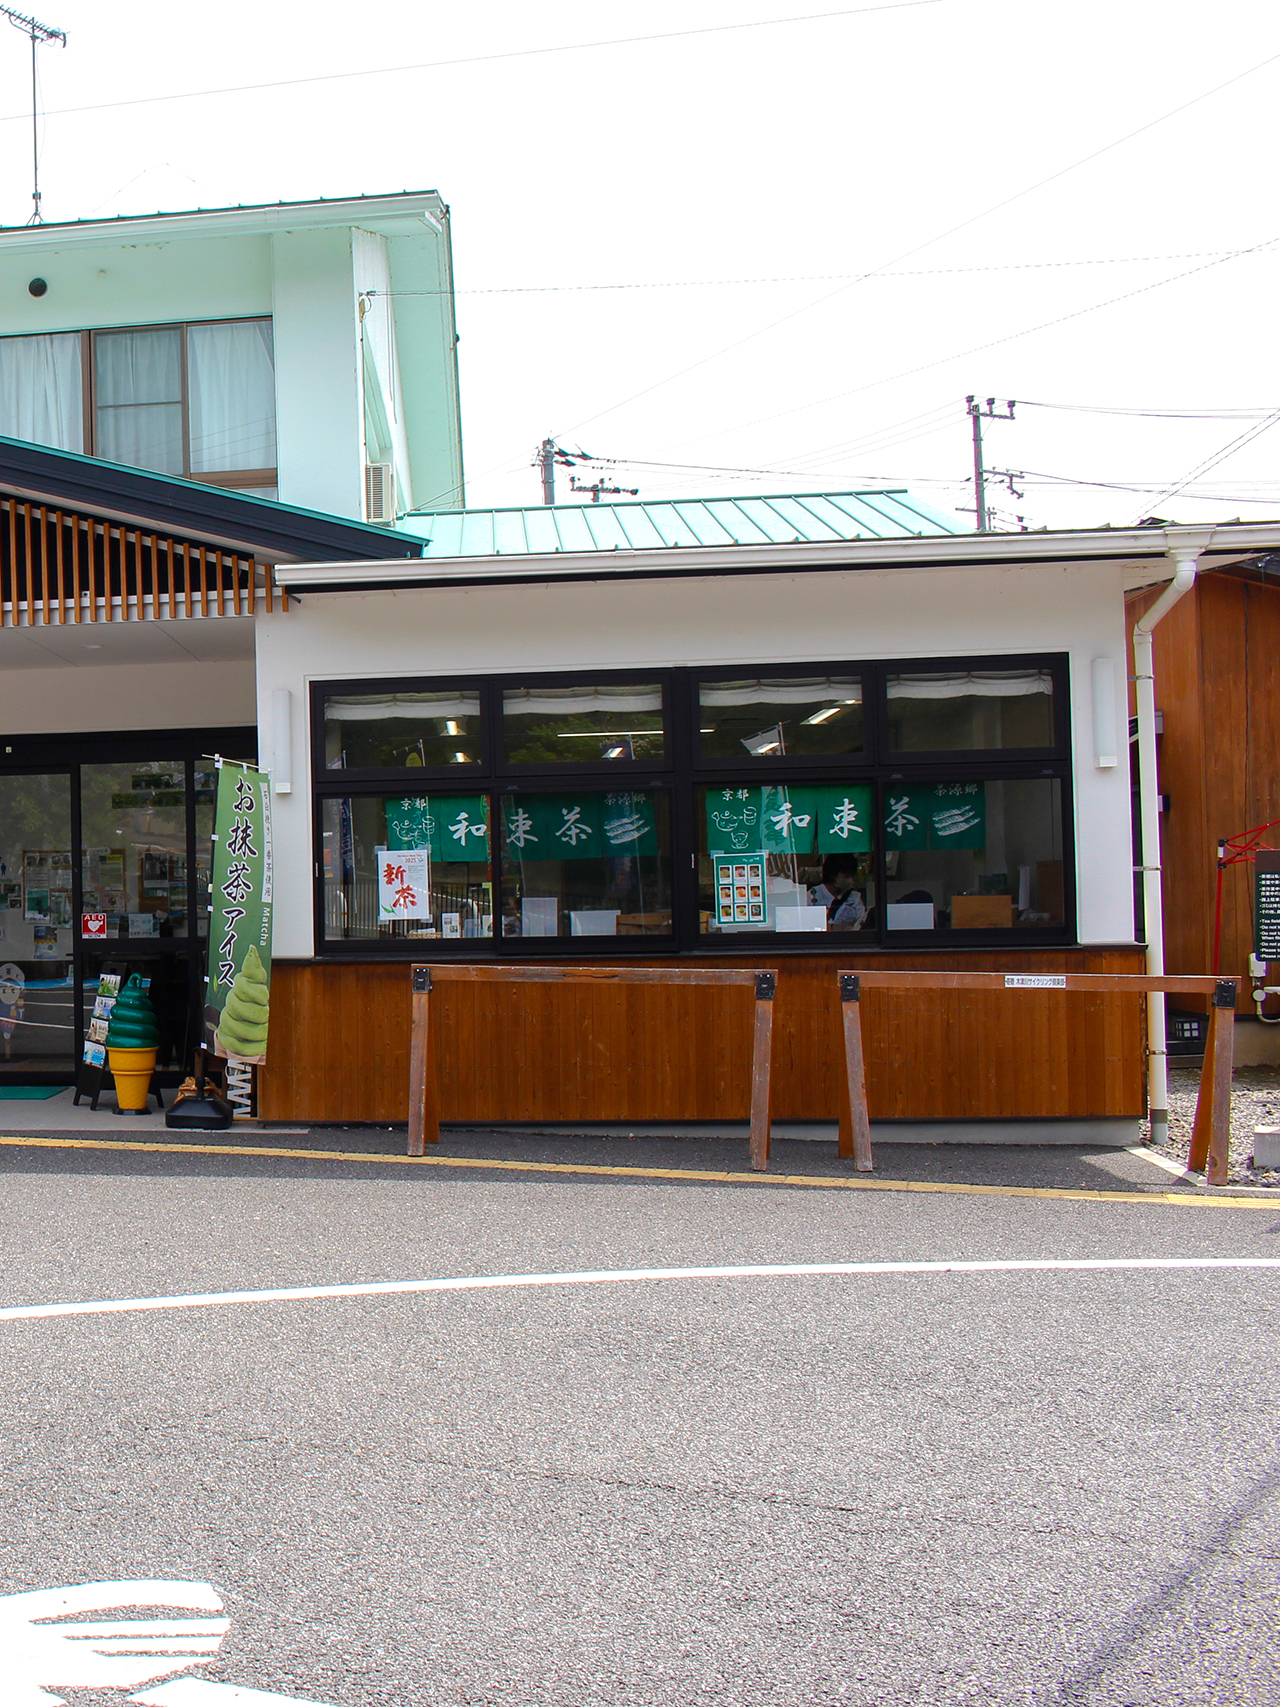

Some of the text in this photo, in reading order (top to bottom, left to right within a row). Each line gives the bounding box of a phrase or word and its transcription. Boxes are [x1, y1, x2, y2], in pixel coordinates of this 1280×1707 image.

[400, 797, 427, 812] 京都
[721, 788, 750, 802] 京都
[770, 796, 920, 839] 和束茶
[218, 775, 258, 987] お抹茶アイス
[383, 862, 418, 910] 新茶
[260, 907, 270, 946] Matcha
